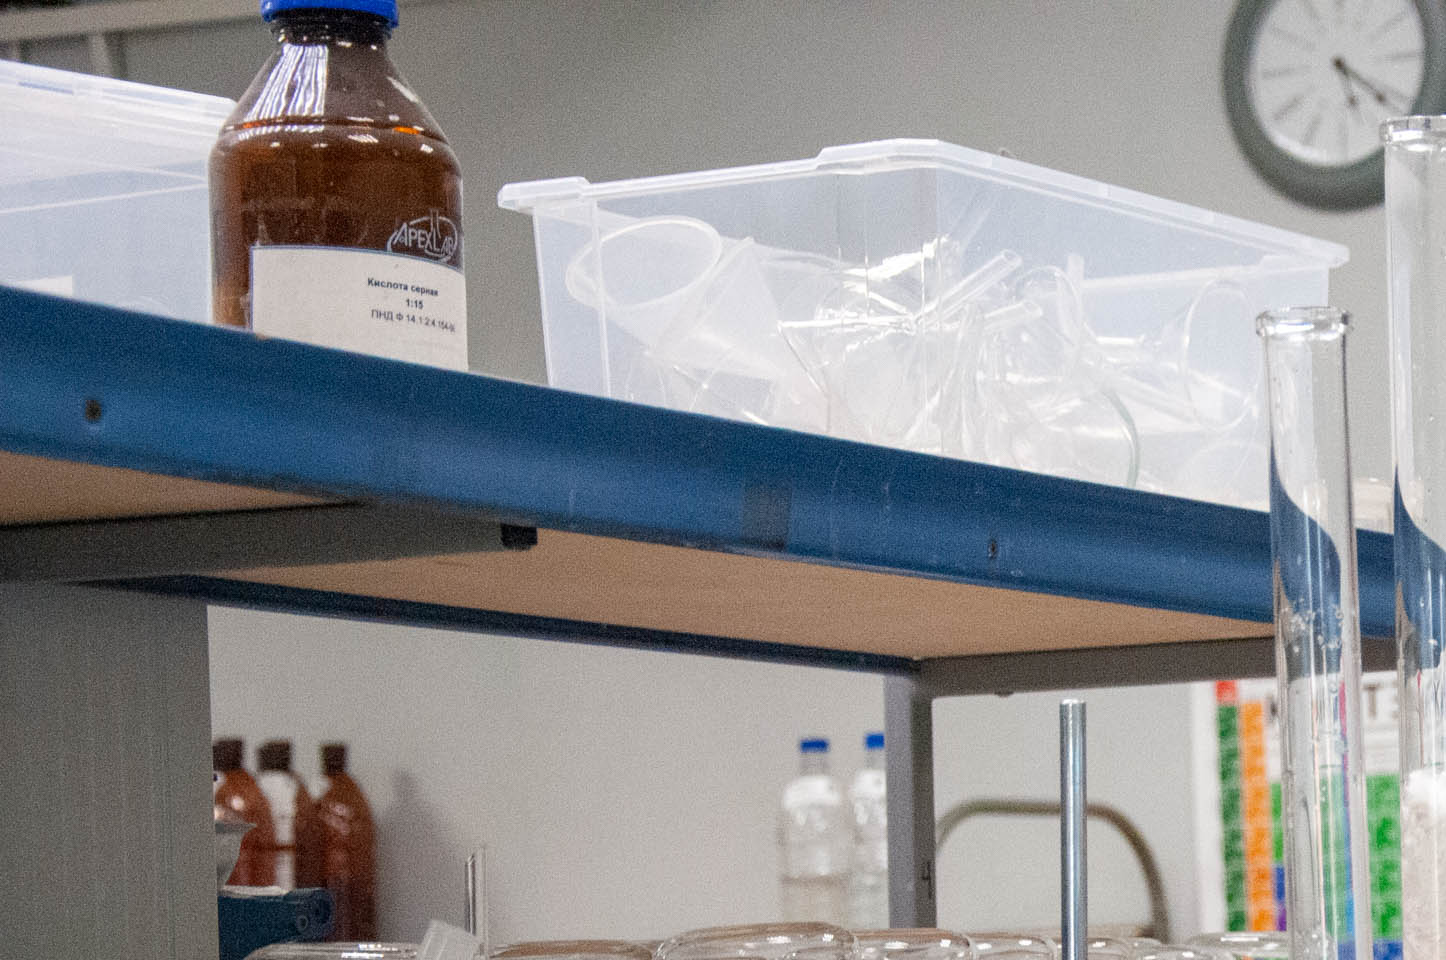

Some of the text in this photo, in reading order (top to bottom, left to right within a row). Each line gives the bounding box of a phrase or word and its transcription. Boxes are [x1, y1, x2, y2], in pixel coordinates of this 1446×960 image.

[367, 277, 439, 297] Кислота серная
[405, 298, 424, 310] 1:15
[371, 308, 394, 322] ПНД
[396, 312, 404, 321] Ф
